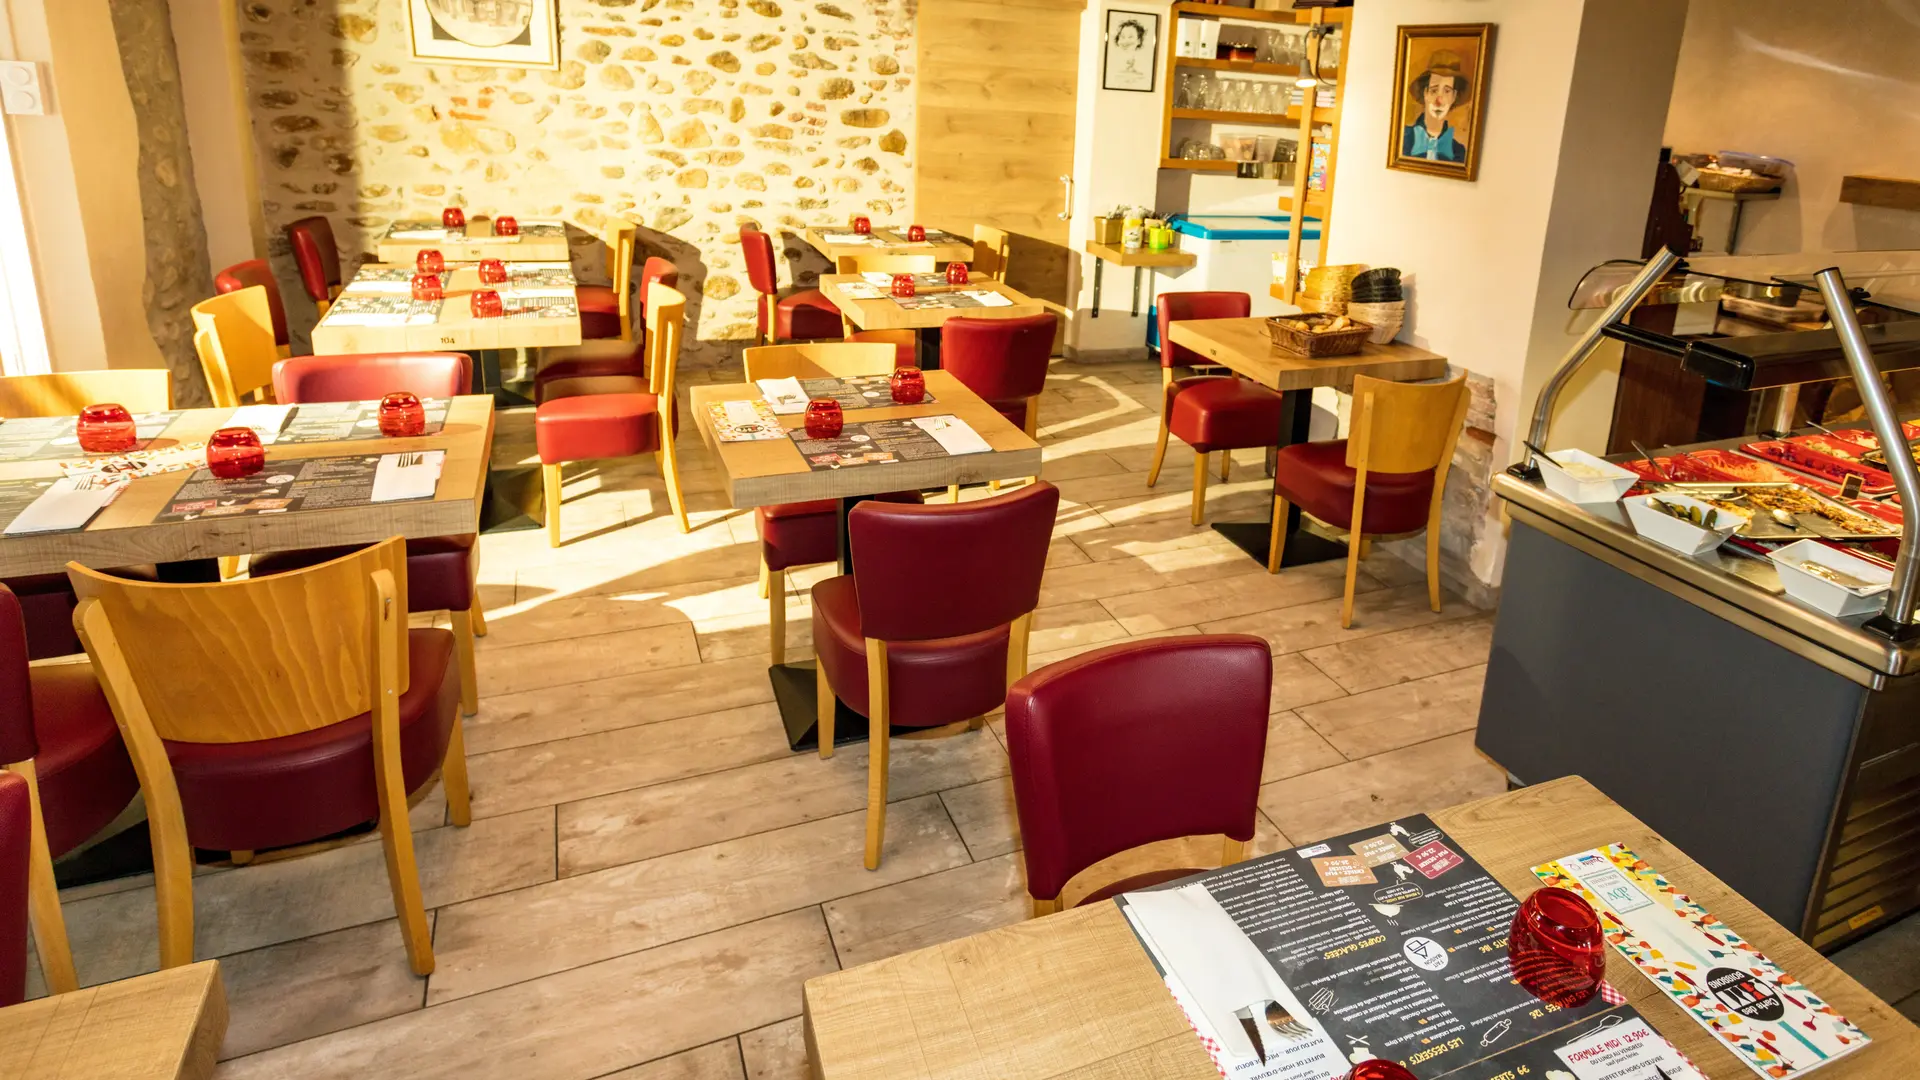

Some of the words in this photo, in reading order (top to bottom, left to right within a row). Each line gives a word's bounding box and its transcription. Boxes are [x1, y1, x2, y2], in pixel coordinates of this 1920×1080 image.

[1356, 933, 1388, 949] COUPES
[1476, 943, 1494, 954] 18€
[1423, 953, 1443, 966] MAISON
[1432, 959, 1445, 968] FAIT
[1400, 965, 1415, 974] Café
[1706, 970, 1745, 990] BOISSONS
[1425, 1001, 1447, 1012] Mousse
[1754, 997, 1781, 1012] Carte
[1399, 1010, 1423, 1022] chocolat
[1419, 1007, 1429, 1015] au
[1526, 1008, 1546, 1020] 12€
[1739, 1005, 1762, 1018] des
[1434, 1020, 1447, 1029] aux
[1443, 1015, 1460, 1026] Tarte
[1447, 1024, 1467, 1035] Crème
[1395, 1035, 1405, 1043] et
[1401, 1031, 1416, 1041] miel
[1298, 1042, 1311, 1050] DU
[1307, 1037, 1324, 1047] PLAT
[1382, 1037, 1399, 1048] thym
[1445, 1036, 1464, 1050] LES
[1283, 1045, 1301, 1055] JOUR
[1406, 1042, 1449, 1066] DESSERTS
[1566, 1043, 1607, 1065] FORMULE
[1601, 1037, 1624, 1051] MIDI
[1588, 1058, 1600, 1066] DU
[1596, 1052, 1615, 1063] LUNDI
[1618, 1041, 1645, 1055] VENDREDI
[1294, 1059, 1305, 1068] DE
[1302, 1052, 1326, 1065] BUFFET
[1604, 1059, 1617, 1067] sauf
[1233, 1060, 1256, 1073] BOEUF
